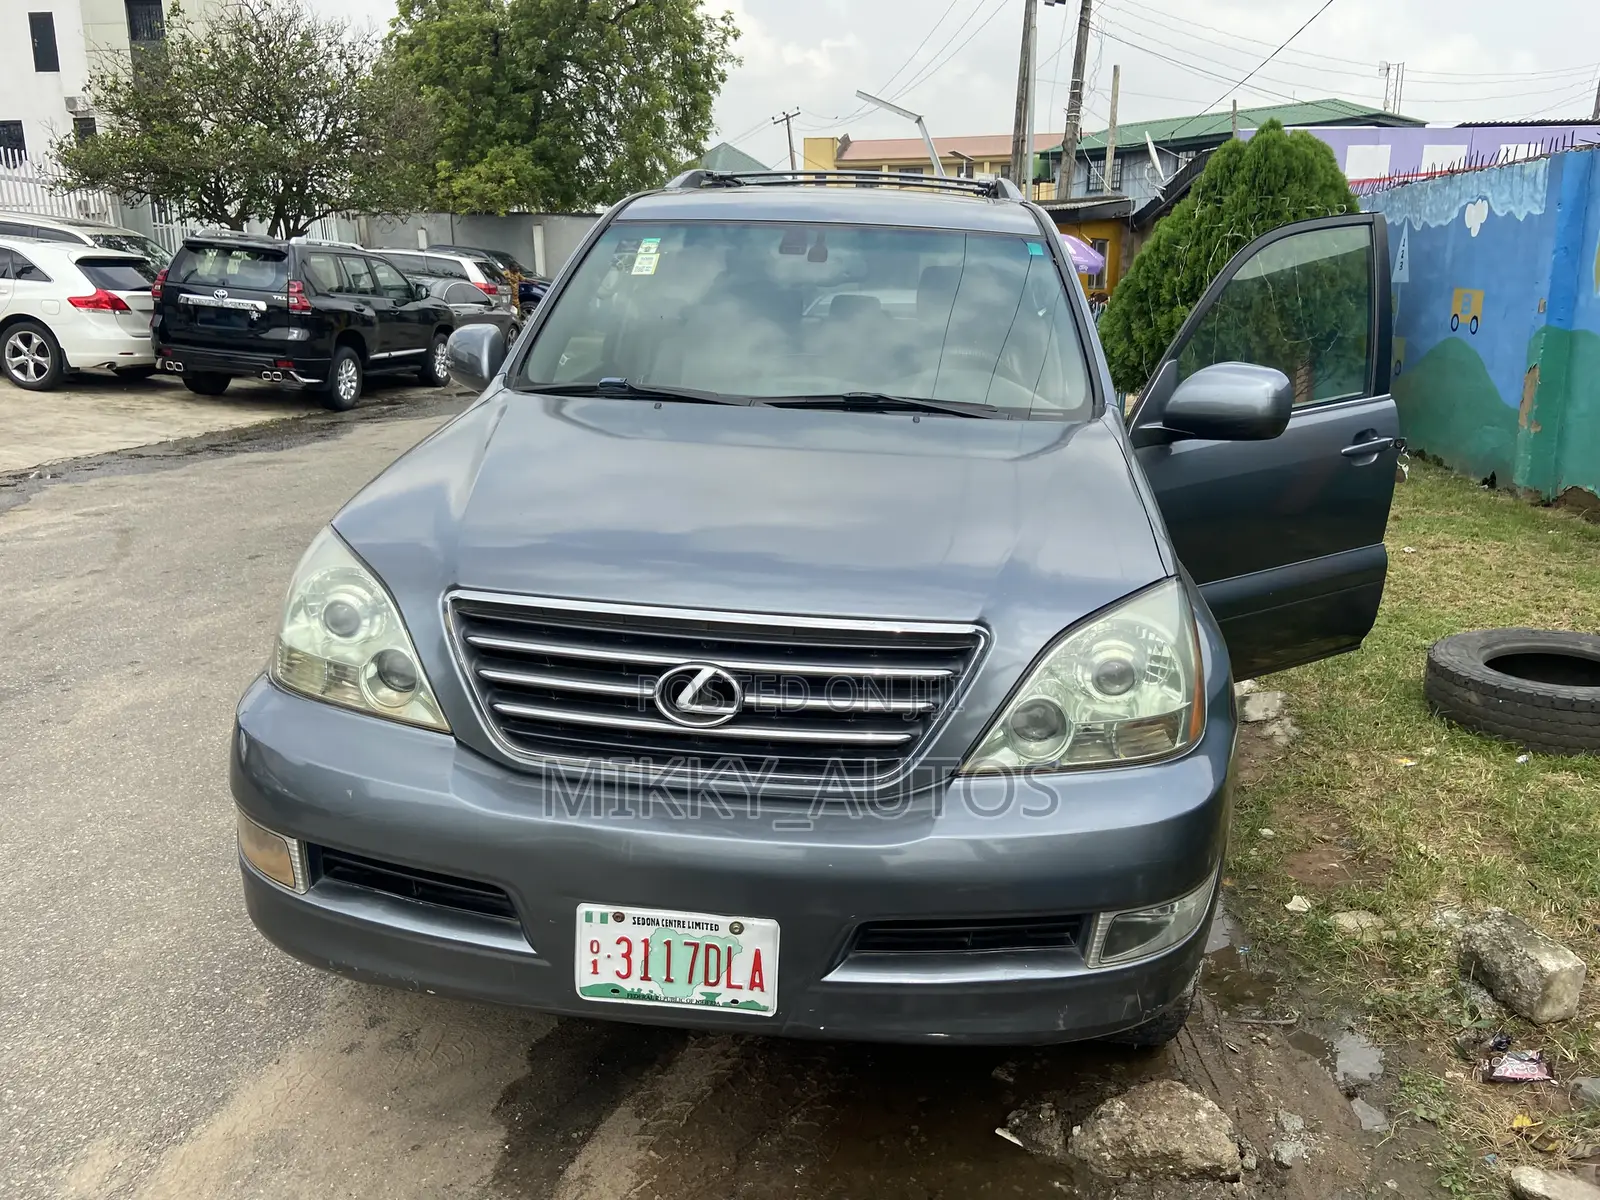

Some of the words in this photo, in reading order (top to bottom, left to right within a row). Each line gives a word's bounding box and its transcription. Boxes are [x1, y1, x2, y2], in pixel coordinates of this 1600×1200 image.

[632, 916, 660, 927] SEDONA
[661, 918, 686, 929] CENTRE
[687, 920, 720, 932] LIMITED
[615, 935, 765, 992] 3117DLA
